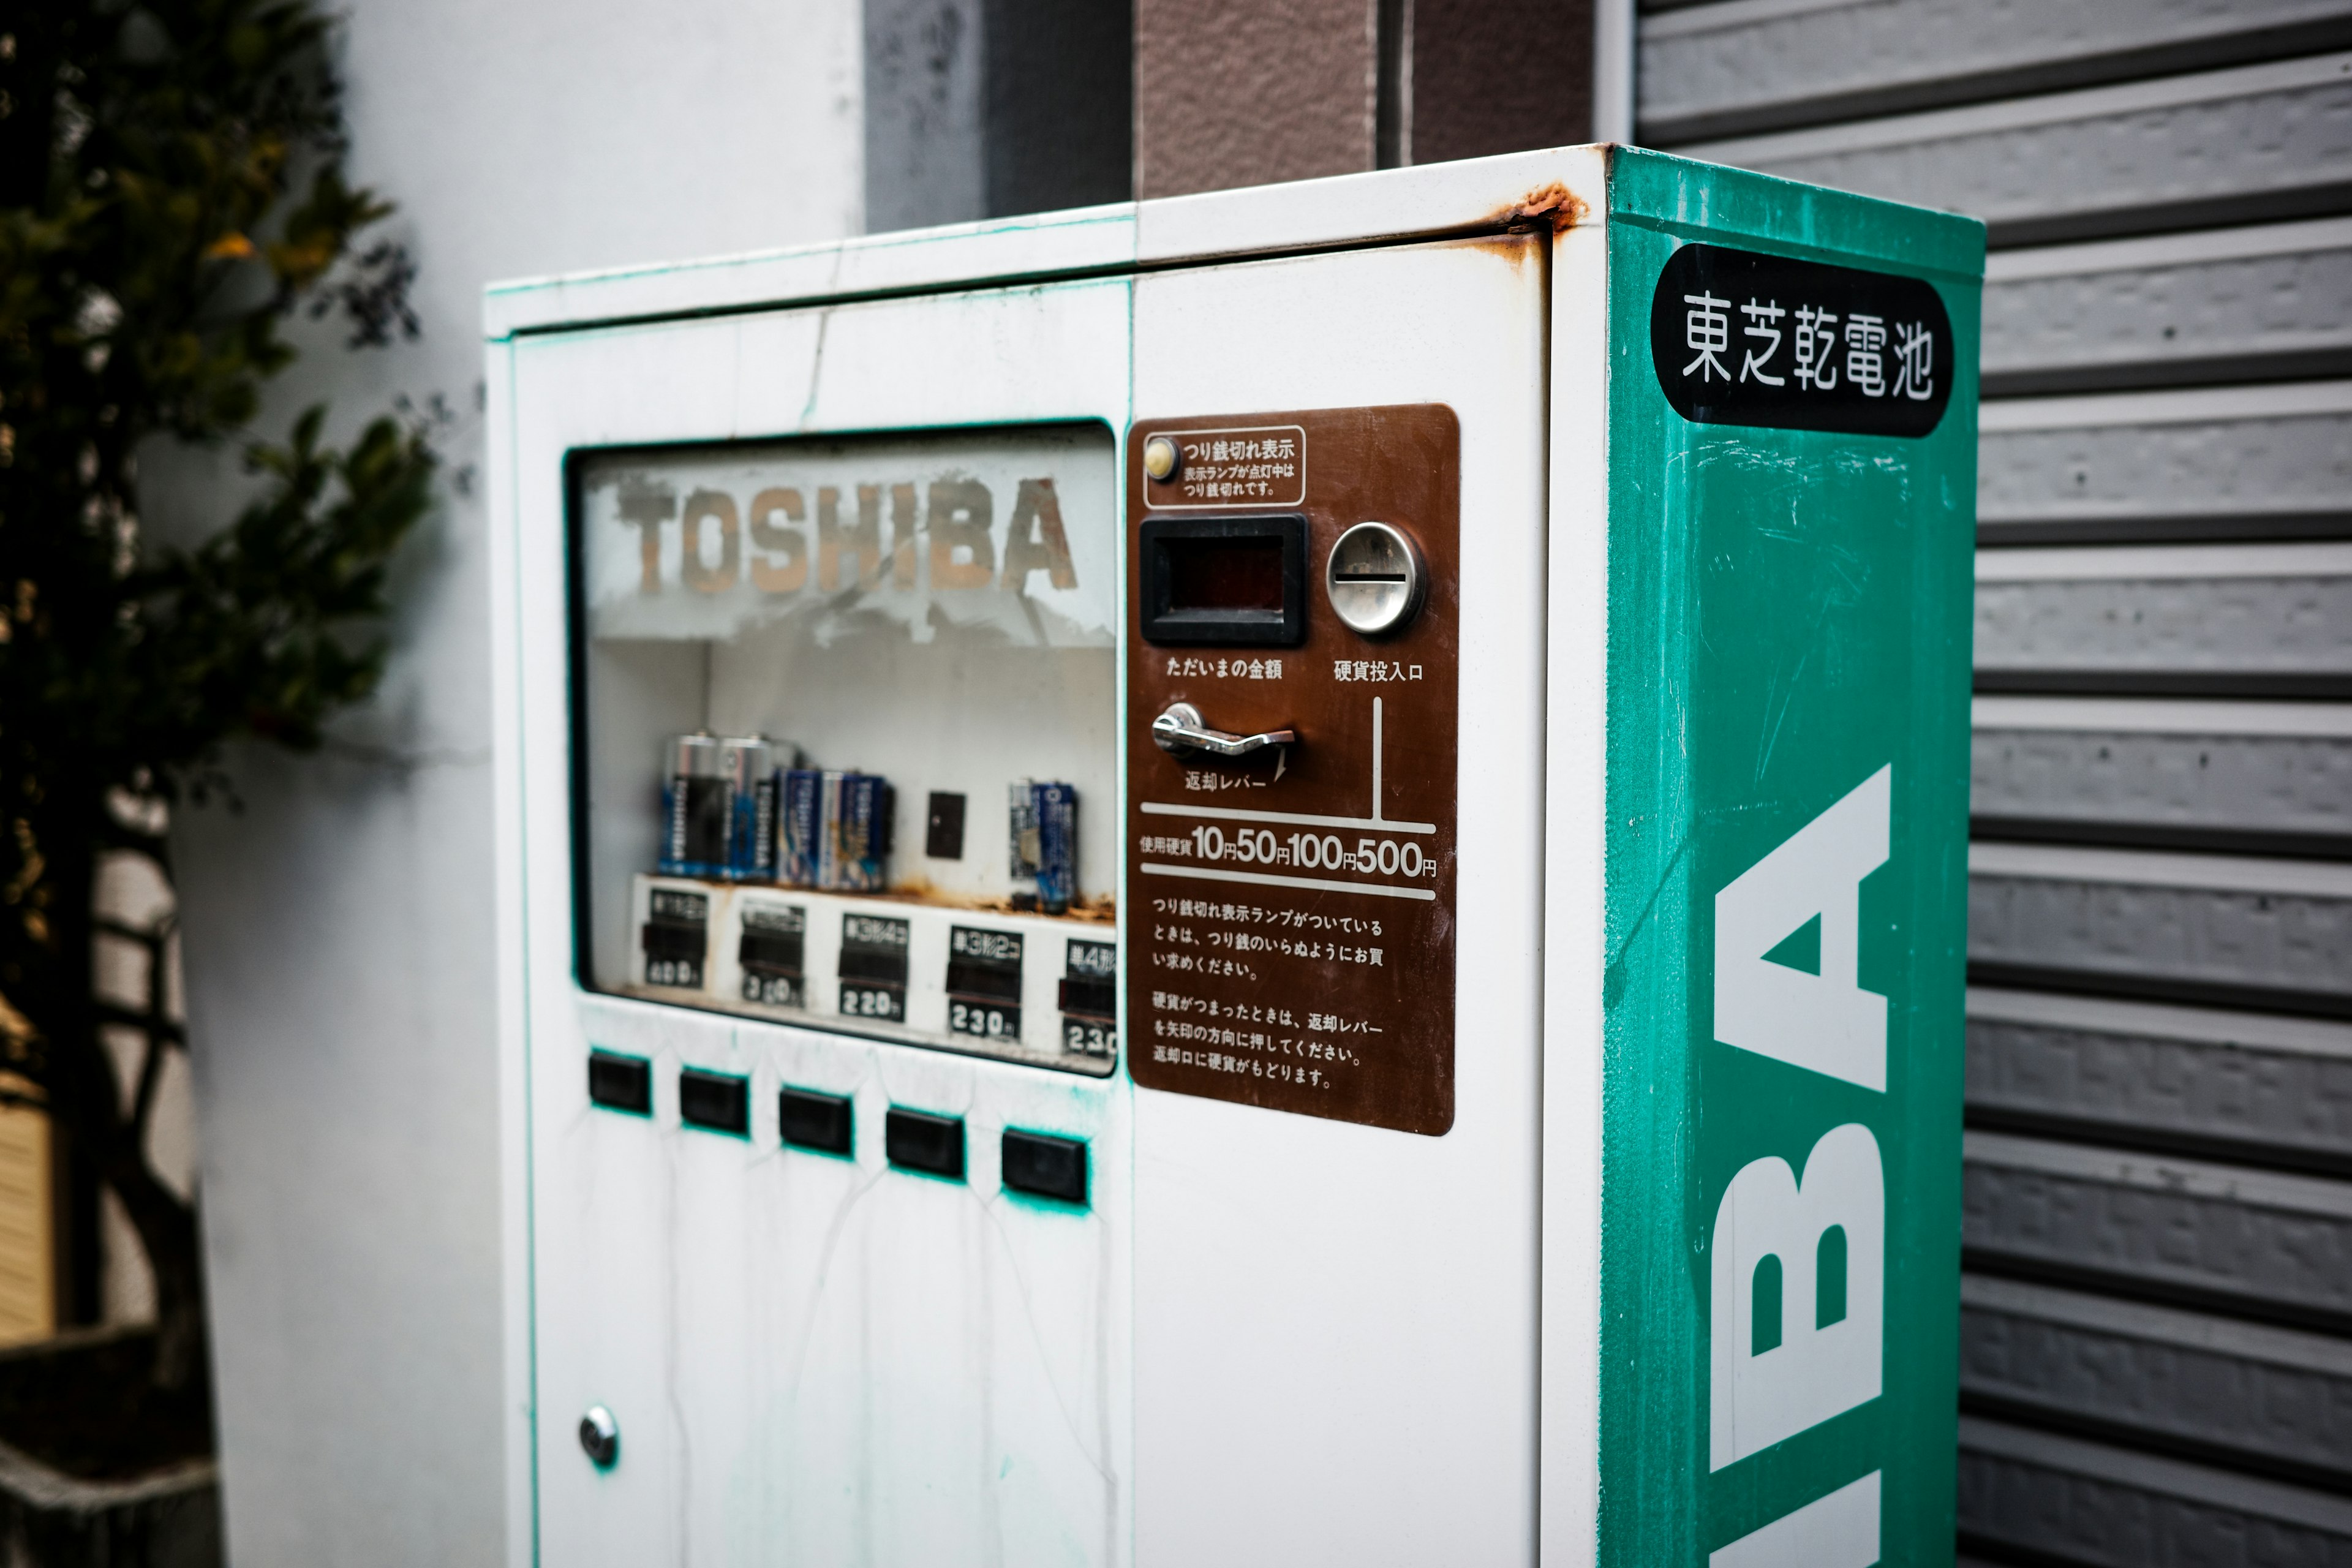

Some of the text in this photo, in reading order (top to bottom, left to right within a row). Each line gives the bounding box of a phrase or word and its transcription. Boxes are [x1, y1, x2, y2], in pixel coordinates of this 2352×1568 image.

[1683, 290, 1933, 401] 東芝乾電池
[1183, 439, 1295, 461] つり銭切れ表示
[1184, 462, 1295, 481] 表示ランプが点灯中は
[1183, 480, 1274, 497] つり銭切れです。
[615, 477, 1078, 595] TOSHIBA
[1166, 657, 1283, 680] ただいまの金額
[1334, 660, 1423, 682] 硬貨投入口
[1185, 771, 1266, 792] 返却レバー
[1139, 835, 1193, 856] 使用硬貨
[1153, 898, 1383, 937] つり銭切れ表示ランプがついている
[1153, 924, 1384, 967] ときは、つり銭のいらぬようにお買
[1153, 952, 1257, 981] い求めください。
[1152, 991, 1384, 1035] 硬貨がつまったときは、返却レバー
[1153, 1019, 1360, 1066] を矢印の方向に押してください。
[1153, 1045, 1330, 1090] 返却口に硬貨がもどります。
